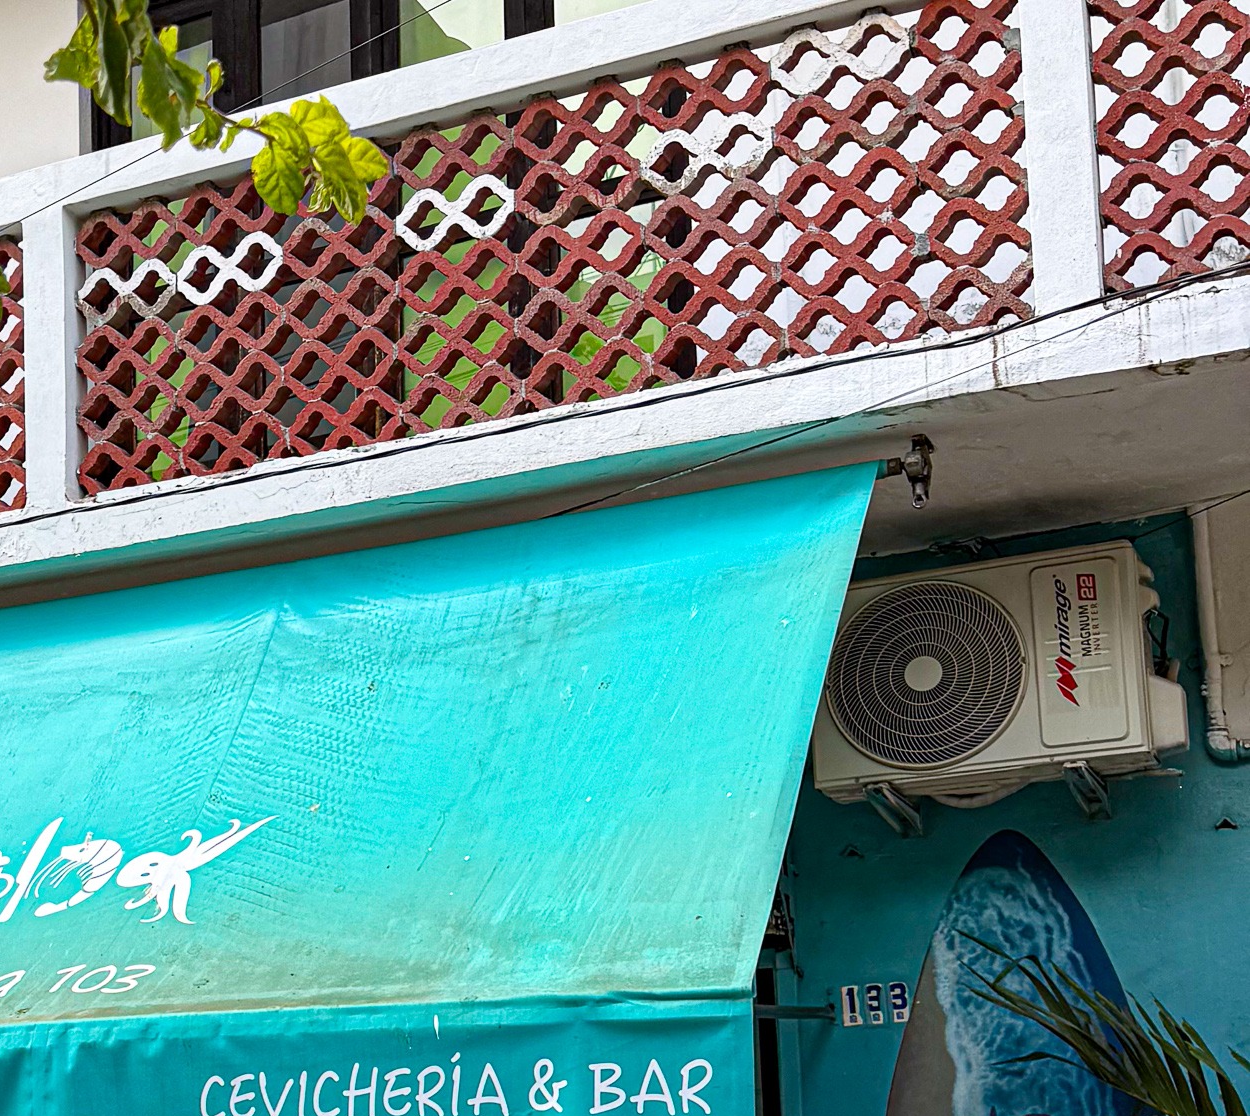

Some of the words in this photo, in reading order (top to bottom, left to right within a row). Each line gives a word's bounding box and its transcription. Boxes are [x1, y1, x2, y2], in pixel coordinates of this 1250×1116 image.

[1079, 576, 1094, 599] 22
[1054, 578, 1071, 657] mirage
[1078, 604, 1093, 657] MAGNUM
[1090, 602, 1102, 656] INVERTER
[48, 963, 157, 995] 103
[527, 1058, 569, 1114] &
[587, 1058, 714, 1116] BAR
